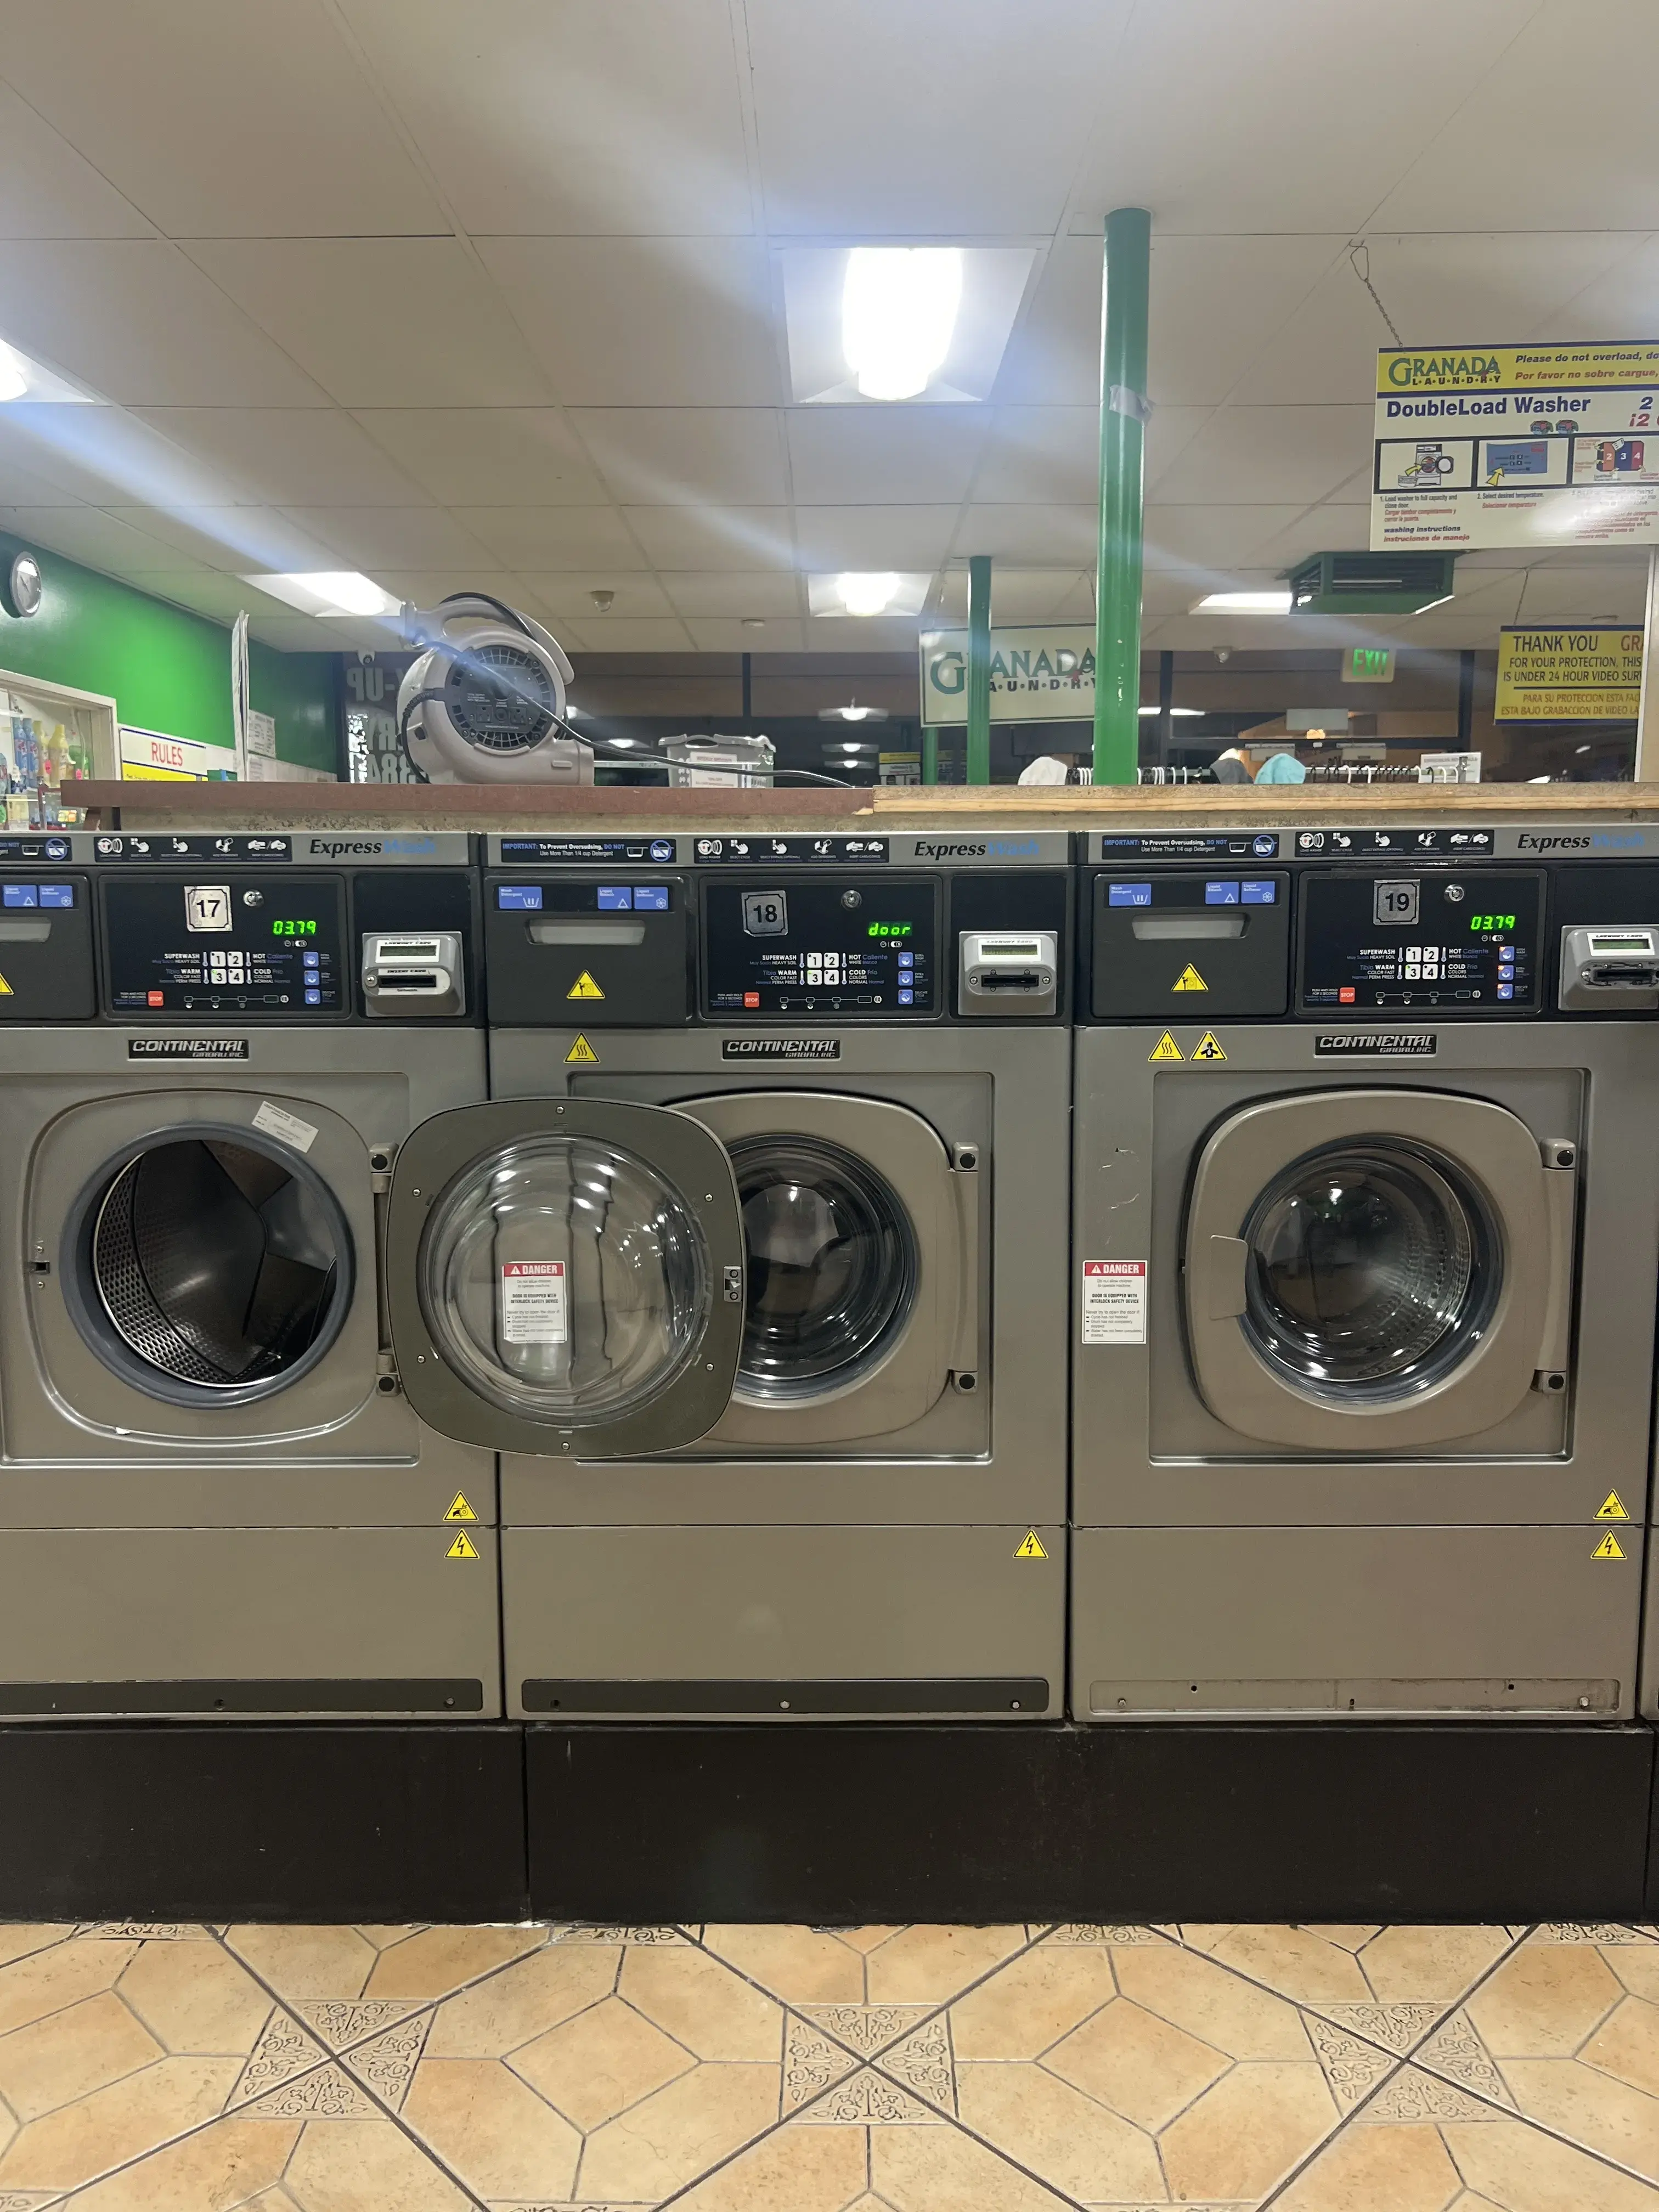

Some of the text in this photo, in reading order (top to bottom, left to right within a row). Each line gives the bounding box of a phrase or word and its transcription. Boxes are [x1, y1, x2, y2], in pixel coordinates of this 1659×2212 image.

[1516, 355, 1551, 363] Please
[1571, 353, 1589, 362] not
[1593, 352, 1642, 361] overload,
[1389, 356, 1501, 386] GRANADA
[1515, 371, 1534, 380] Por
[1584, 370, 1615, 378] sobre
[1618, 369, 1658, 378] cargue,
[1387, 396, 1591, 417] DoubleLoad Washer
[1639, 397, 1654, 410] 2
[1442, 534, 1470, 542] manejo
[1513, 635, 1599, 652] THANK YOU
[1352, 648, 1388, 676] EXIT
[1509, 657, 1641, 668] FOR YOUR PROTECTION, THIS
[930, 647, 1096, 695] GANADA
[1503, 671, 1511, 681] IS
[1514, 671, 1545, 681] UNDER
[1548, 671, 1559, 681] 24
[1562, 671, 1589, 681] HOUR
[1592, 670, 1619, 681] VIDEO
[1523, 693, 1543, 703] PARA
[1545, 693, 1554, 703] SU
[1606, 693, 1624, 702] ESTA
[1501, 706, 1519, 715] ESTA
[1521, 706, 1541, 715] BAJO
[1593, 706, 1603, 714] DE
[1605, 706, 1626, 714] VIDEO
[150, 742, 183, 766] RULES
[1385, 893, 1409, 912] 19
[195, 900, 221, 918] 17
[753, 904, 778, 923] 18
[868, 923, 911, 936] door
[216, 956, 239, 964] 1 2
[813, 956, 835, 966] 1 2
[1412, 951, 1435, 960] 1 2
[217, 973, 240, 981] 3 4
[812, 974, 835, 983] 3 4
[1410, 968, 1434, 978] 3 4
[133, 1040, 246, 1051] CONTINENTAL
[726, 1041, 836, 1051] CONTINENTAL
[1319, 1036, 1434, 1048] CONTINENTAL
[522, 1265, 557, 1274] DANGER
[1103, 1264, 1139, 1274] DANGER
